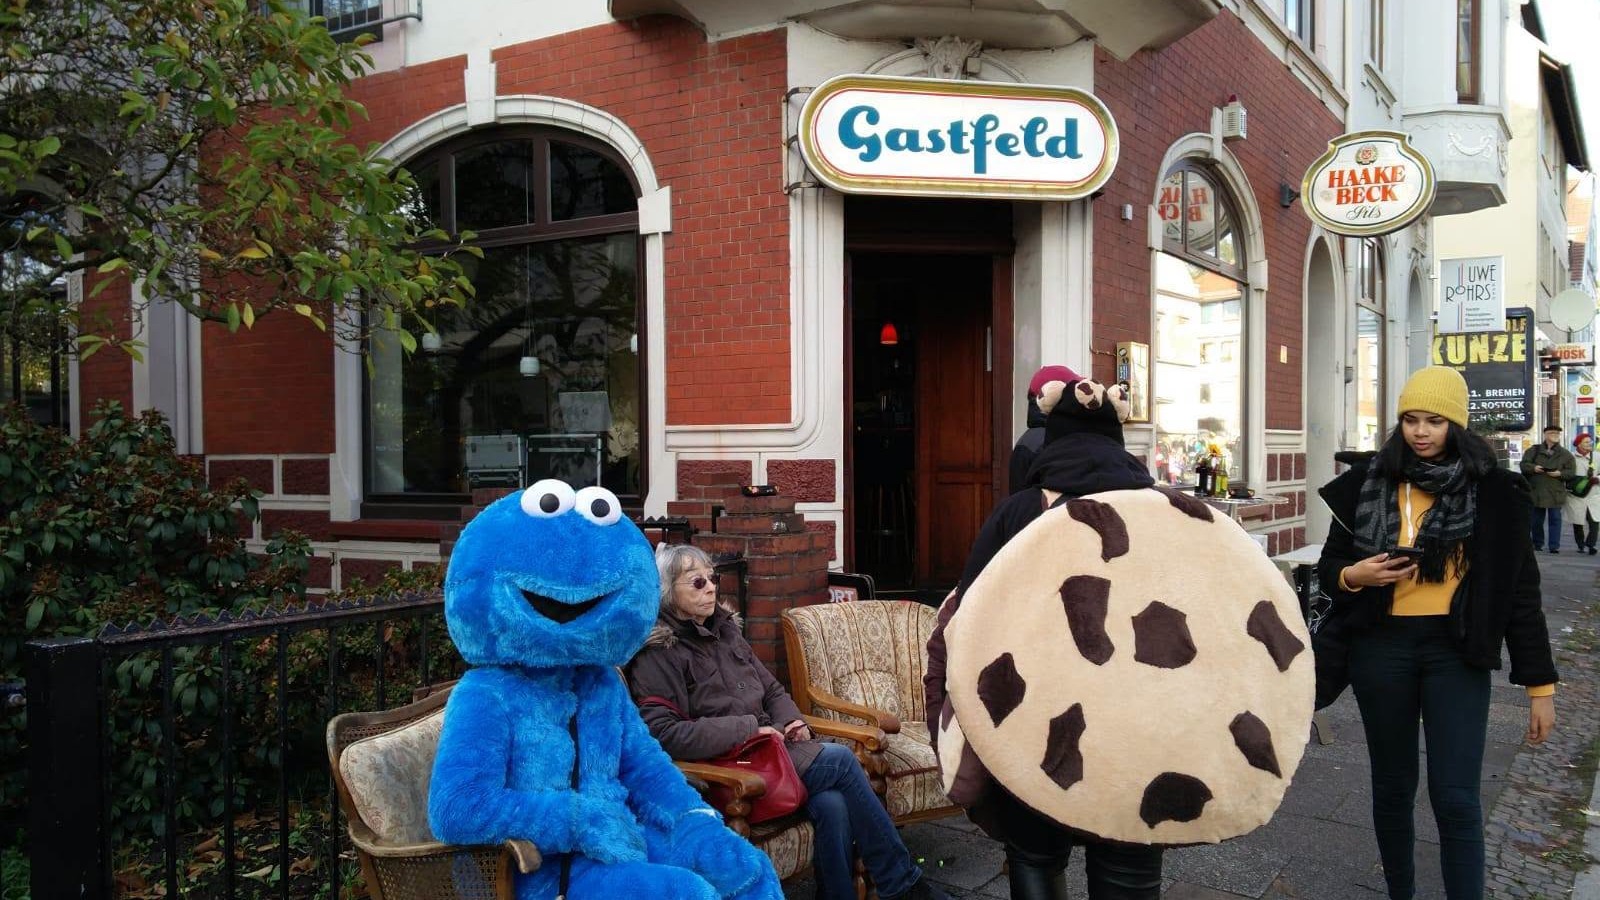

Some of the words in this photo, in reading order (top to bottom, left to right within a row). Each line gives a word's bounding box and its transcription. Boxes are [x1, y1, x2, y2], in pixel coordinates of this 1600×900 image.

[838, 105, 1083, 174] Gastfeld
[1327, 165, 1406, 189] HAAKE
[1336, 184, 1398, 205] BECK
[1345, 205, 1382, 220] Pils
[1468, 264, 1497, 283] UWE
[1486, 388, 1525, 397] BREMEN
[1481, 401, 1525, 409] ROSTOCK
